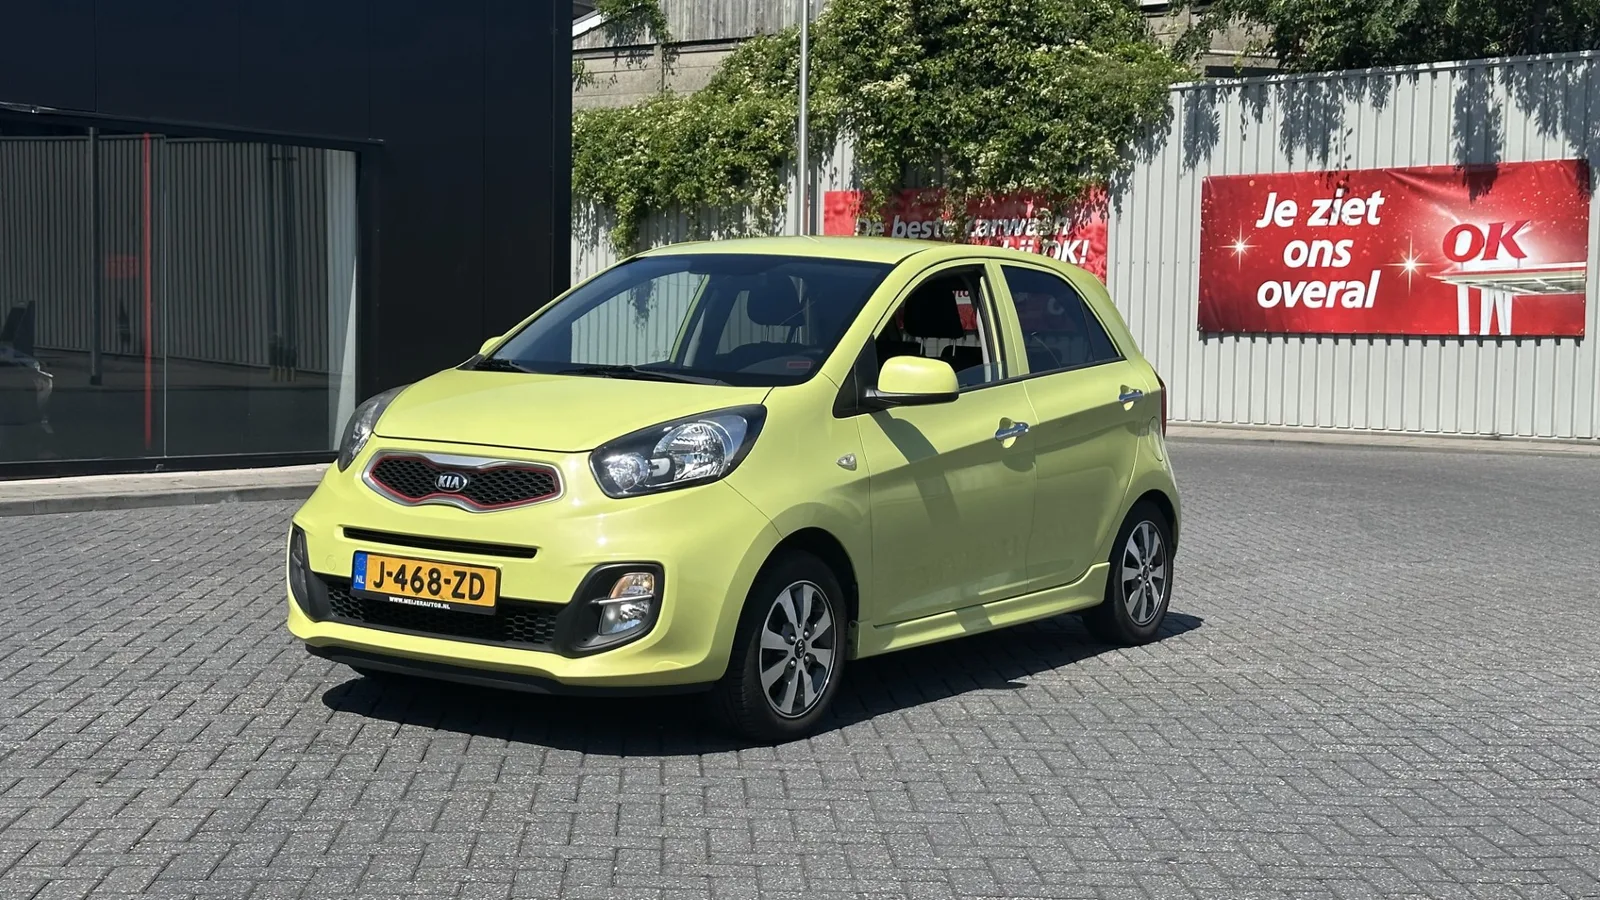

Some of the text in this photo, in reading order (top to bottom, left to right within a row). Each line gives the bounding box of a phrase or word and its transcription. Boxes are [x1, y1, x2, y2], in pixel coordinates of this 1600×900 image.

[964, 213, 1072, 238] carwah
[1255, 188, 1385, 228] Je ziet
[1283, 239, 1353, 269] ons
[1442, 220, 1532, 263] OK
[1256, 269, 1381, 309] overal
[438, 475, 460, 489] KIA
[355, 574, 365, 585] NL
[373, 561, 486, 601] J-468-ZD
